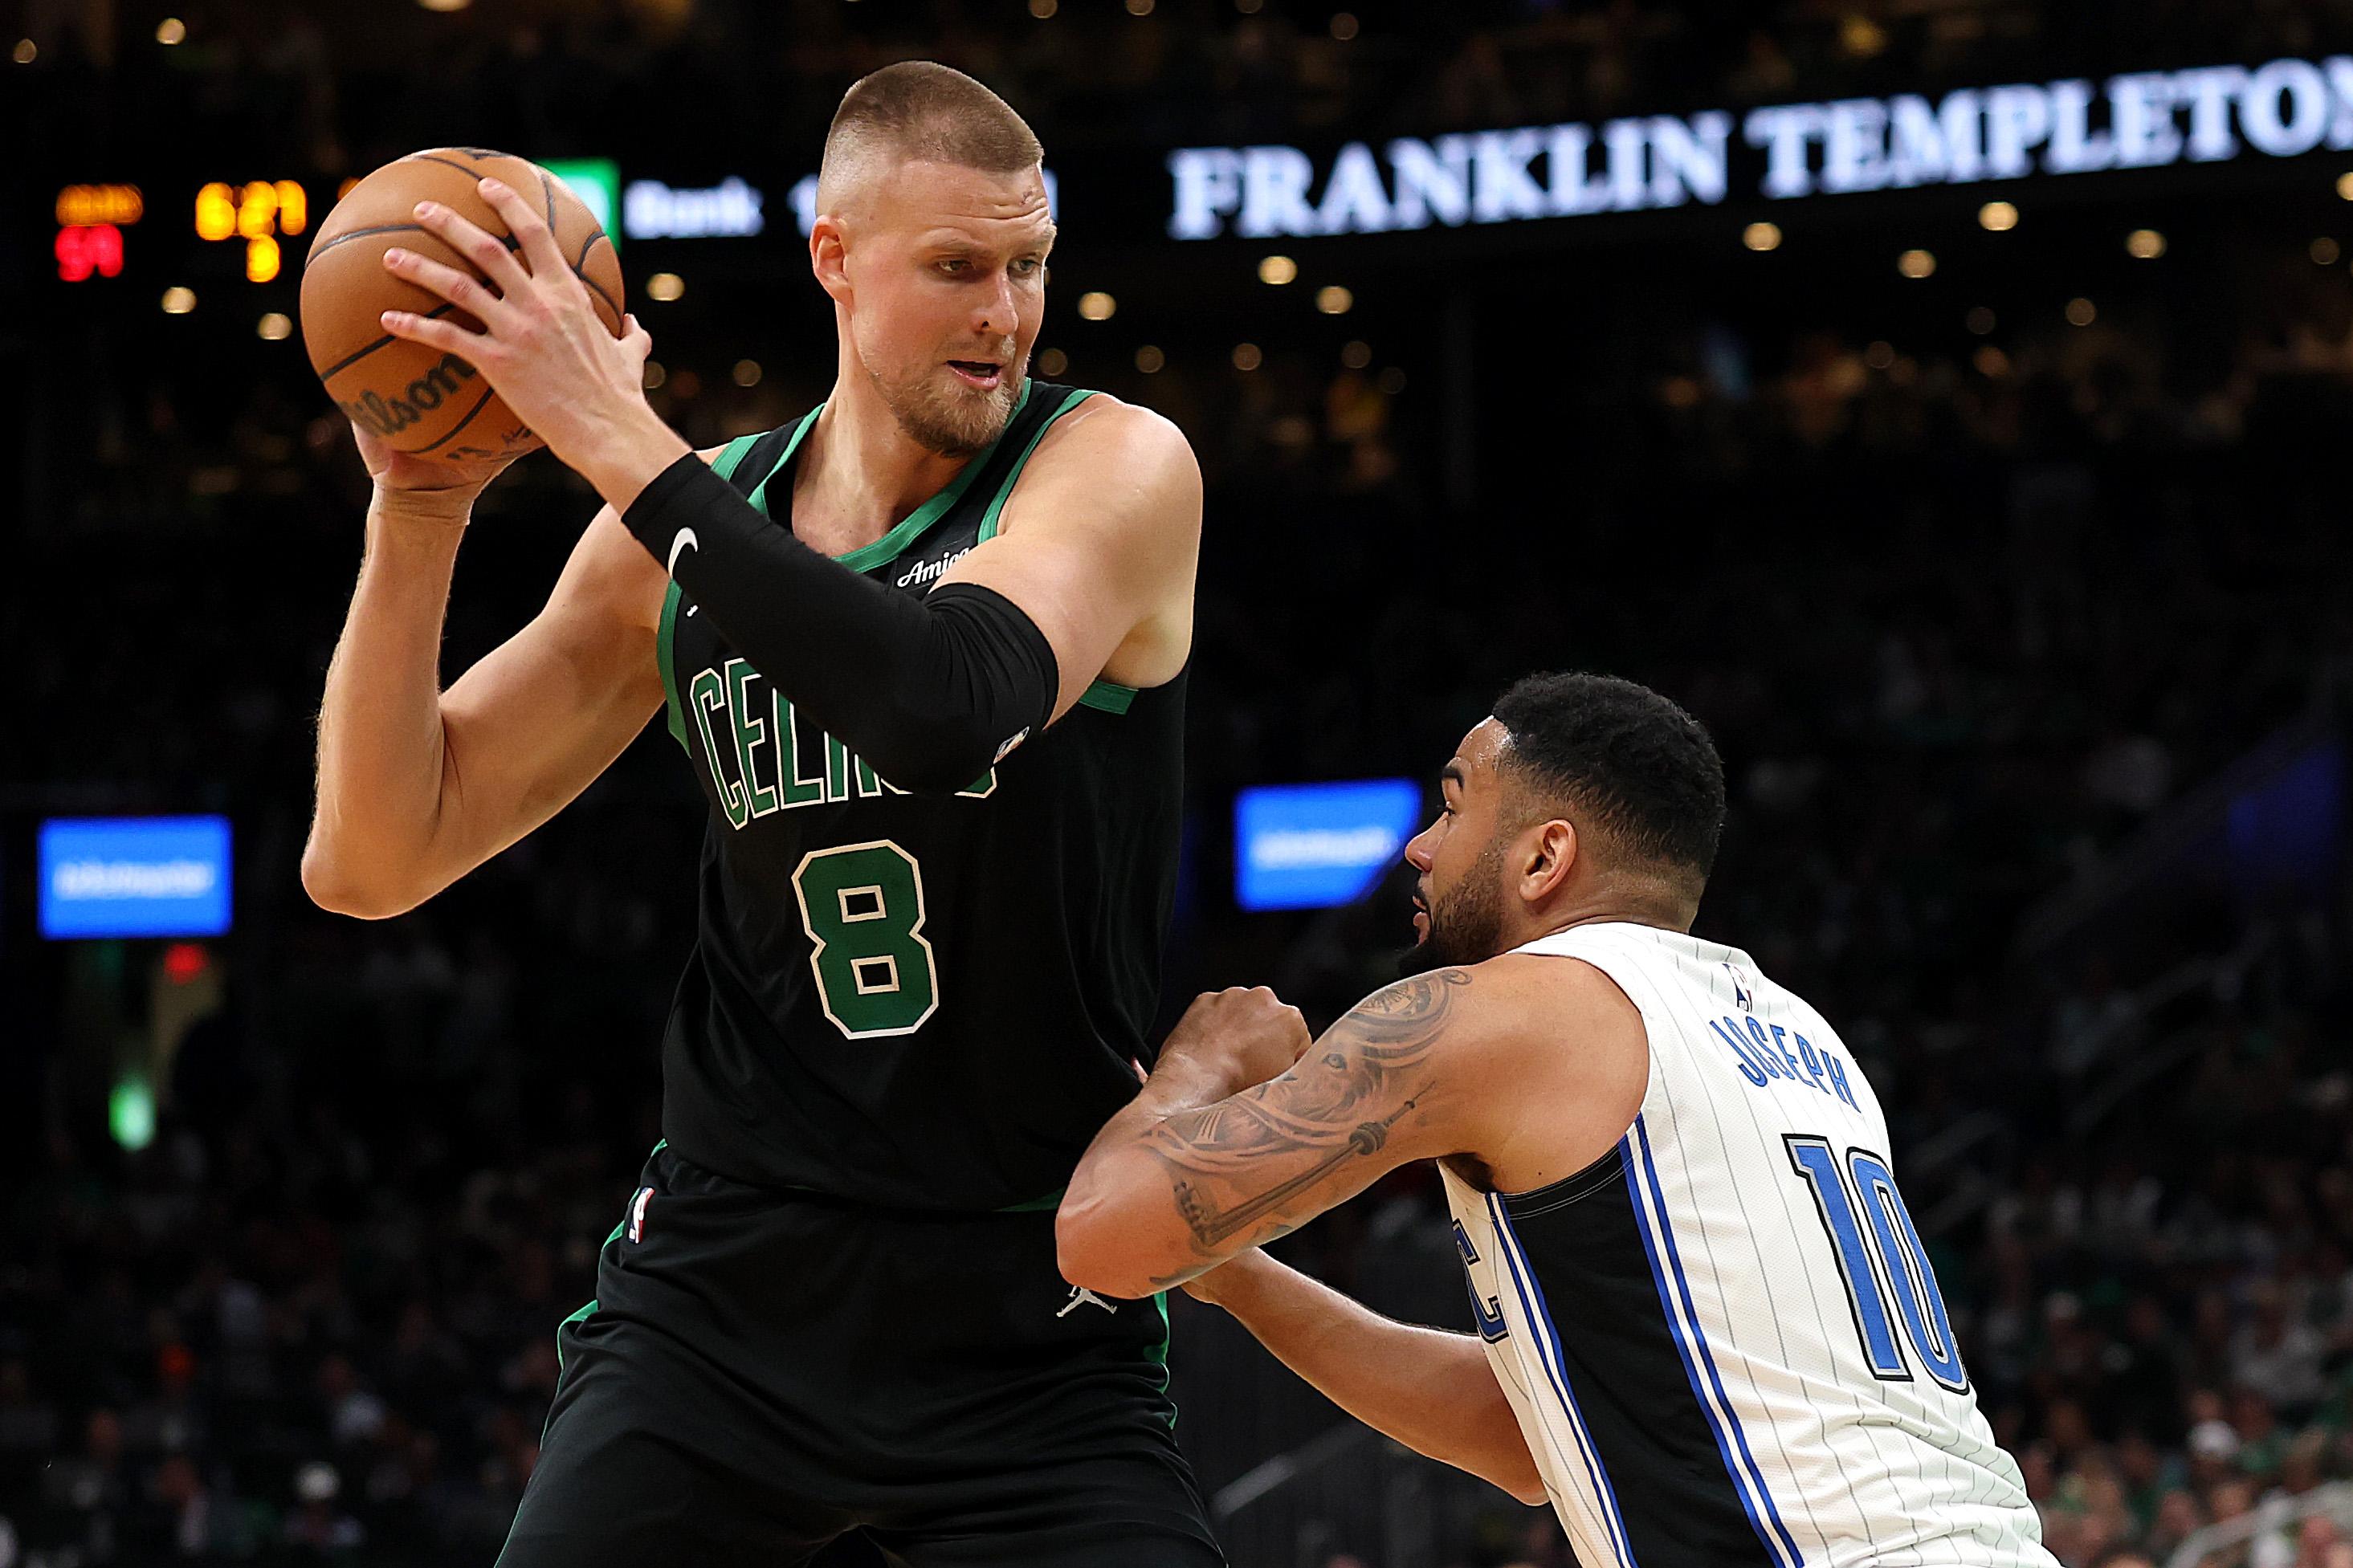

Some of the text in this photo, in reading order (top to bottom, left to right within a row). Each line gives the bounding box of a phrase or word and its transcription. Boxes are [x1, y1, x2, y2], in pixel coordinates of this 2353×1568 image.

[1168, 112, 1731, 240] FRANKLIN
[791, 839, 940, 1040] 8
[1709, 1016, 1862, 1114] JOSEPH
[1782, 1134, 1970, 1395] 10
